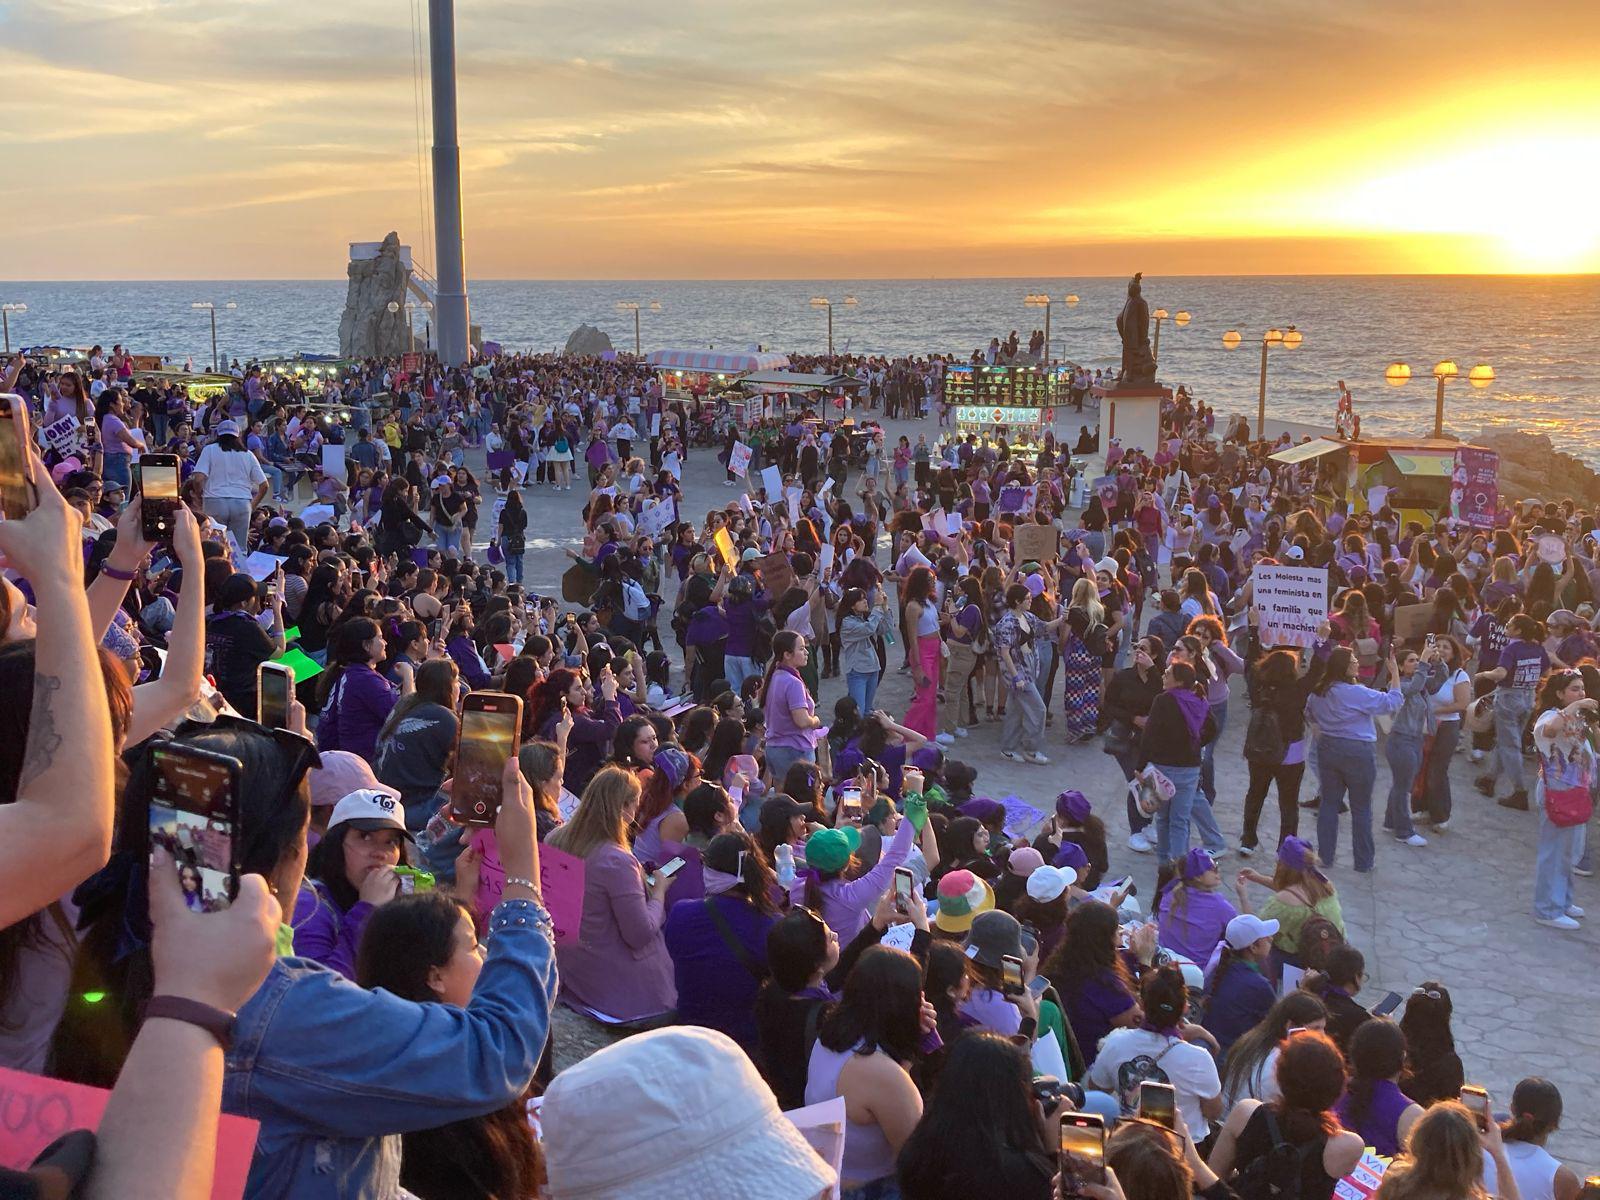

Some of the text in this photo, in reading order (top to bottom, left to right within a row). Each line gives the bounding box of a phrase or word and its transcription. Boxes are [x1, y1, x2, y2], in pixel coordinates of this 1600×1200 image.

[1275, 573, 1303, 582] Molesta
[1307, 576, 1322, 584] mas
[1274, 587, 1310, 598] feminista
[1312, 591, 1322, 599] en
[1258, 603, 1323, 616] la familia que
